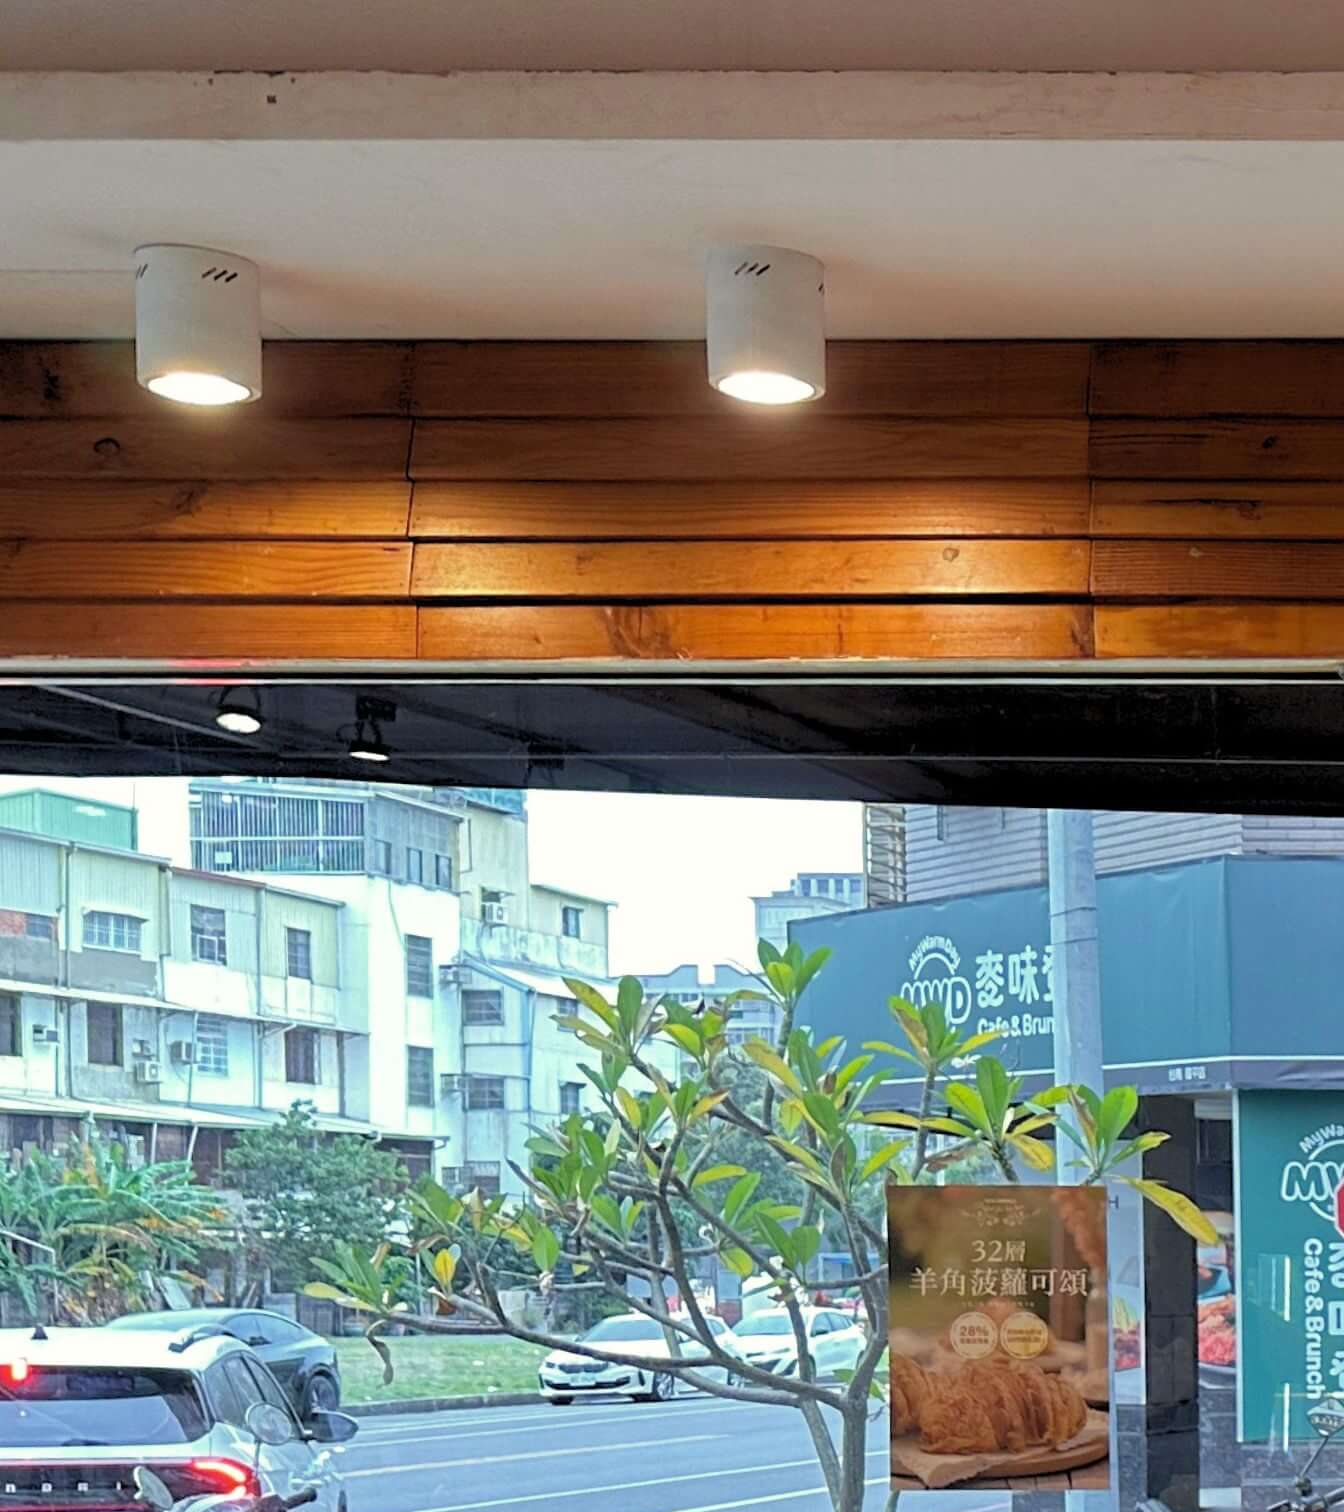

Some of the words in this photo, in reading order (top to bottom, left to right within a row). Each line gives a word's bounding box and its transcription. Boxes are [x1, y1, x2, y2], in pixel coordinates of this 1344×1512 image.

[971, 1240, 1026, 1262] 32層
[910, 1267, 1088, 1297] 羊角菠蘿可頌
